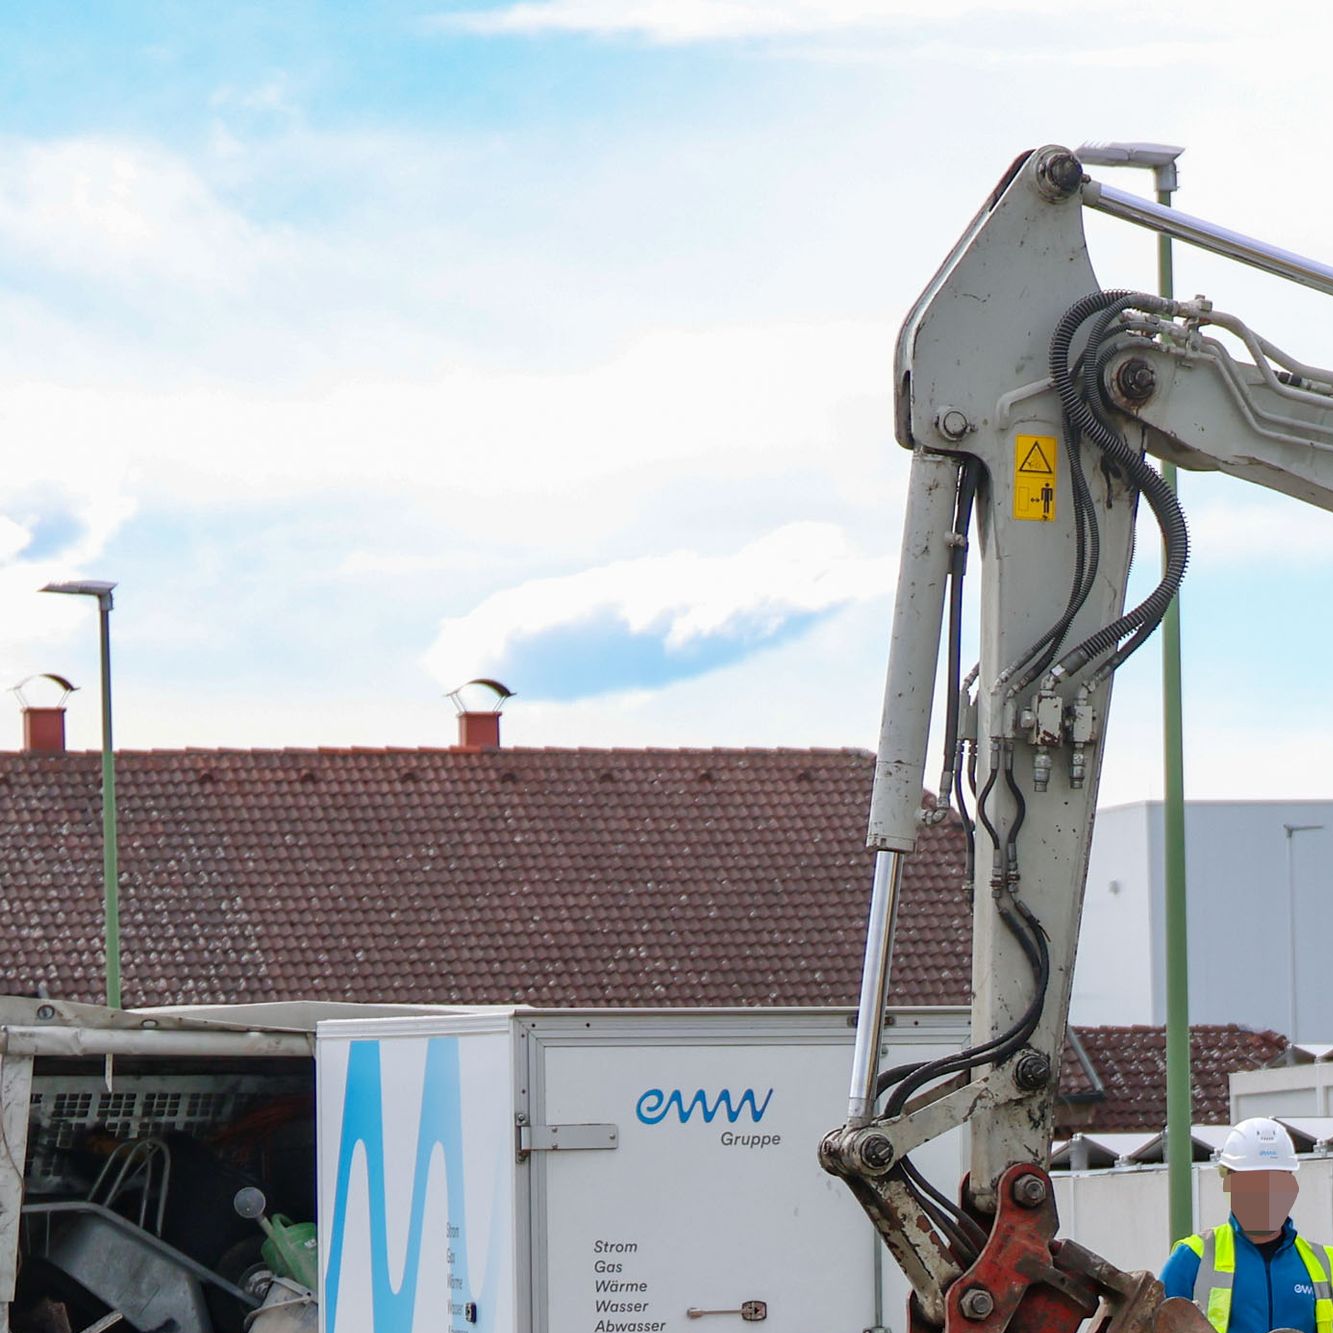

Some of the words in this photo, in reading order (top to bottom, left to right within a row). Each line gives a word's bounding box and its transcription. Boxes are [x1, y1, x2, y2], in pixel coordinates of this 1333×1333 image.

[720, 1131, 781, 1149] Gruppe
[593, 1240, 638, 1253] Strom
[594, 1260, 623, 1273] Gas
[595, 1279, 648, 1292] Wärme
[595, 1300, 649, 1313] Wasser
[594, 1319, 667, 1333] Abwasser
